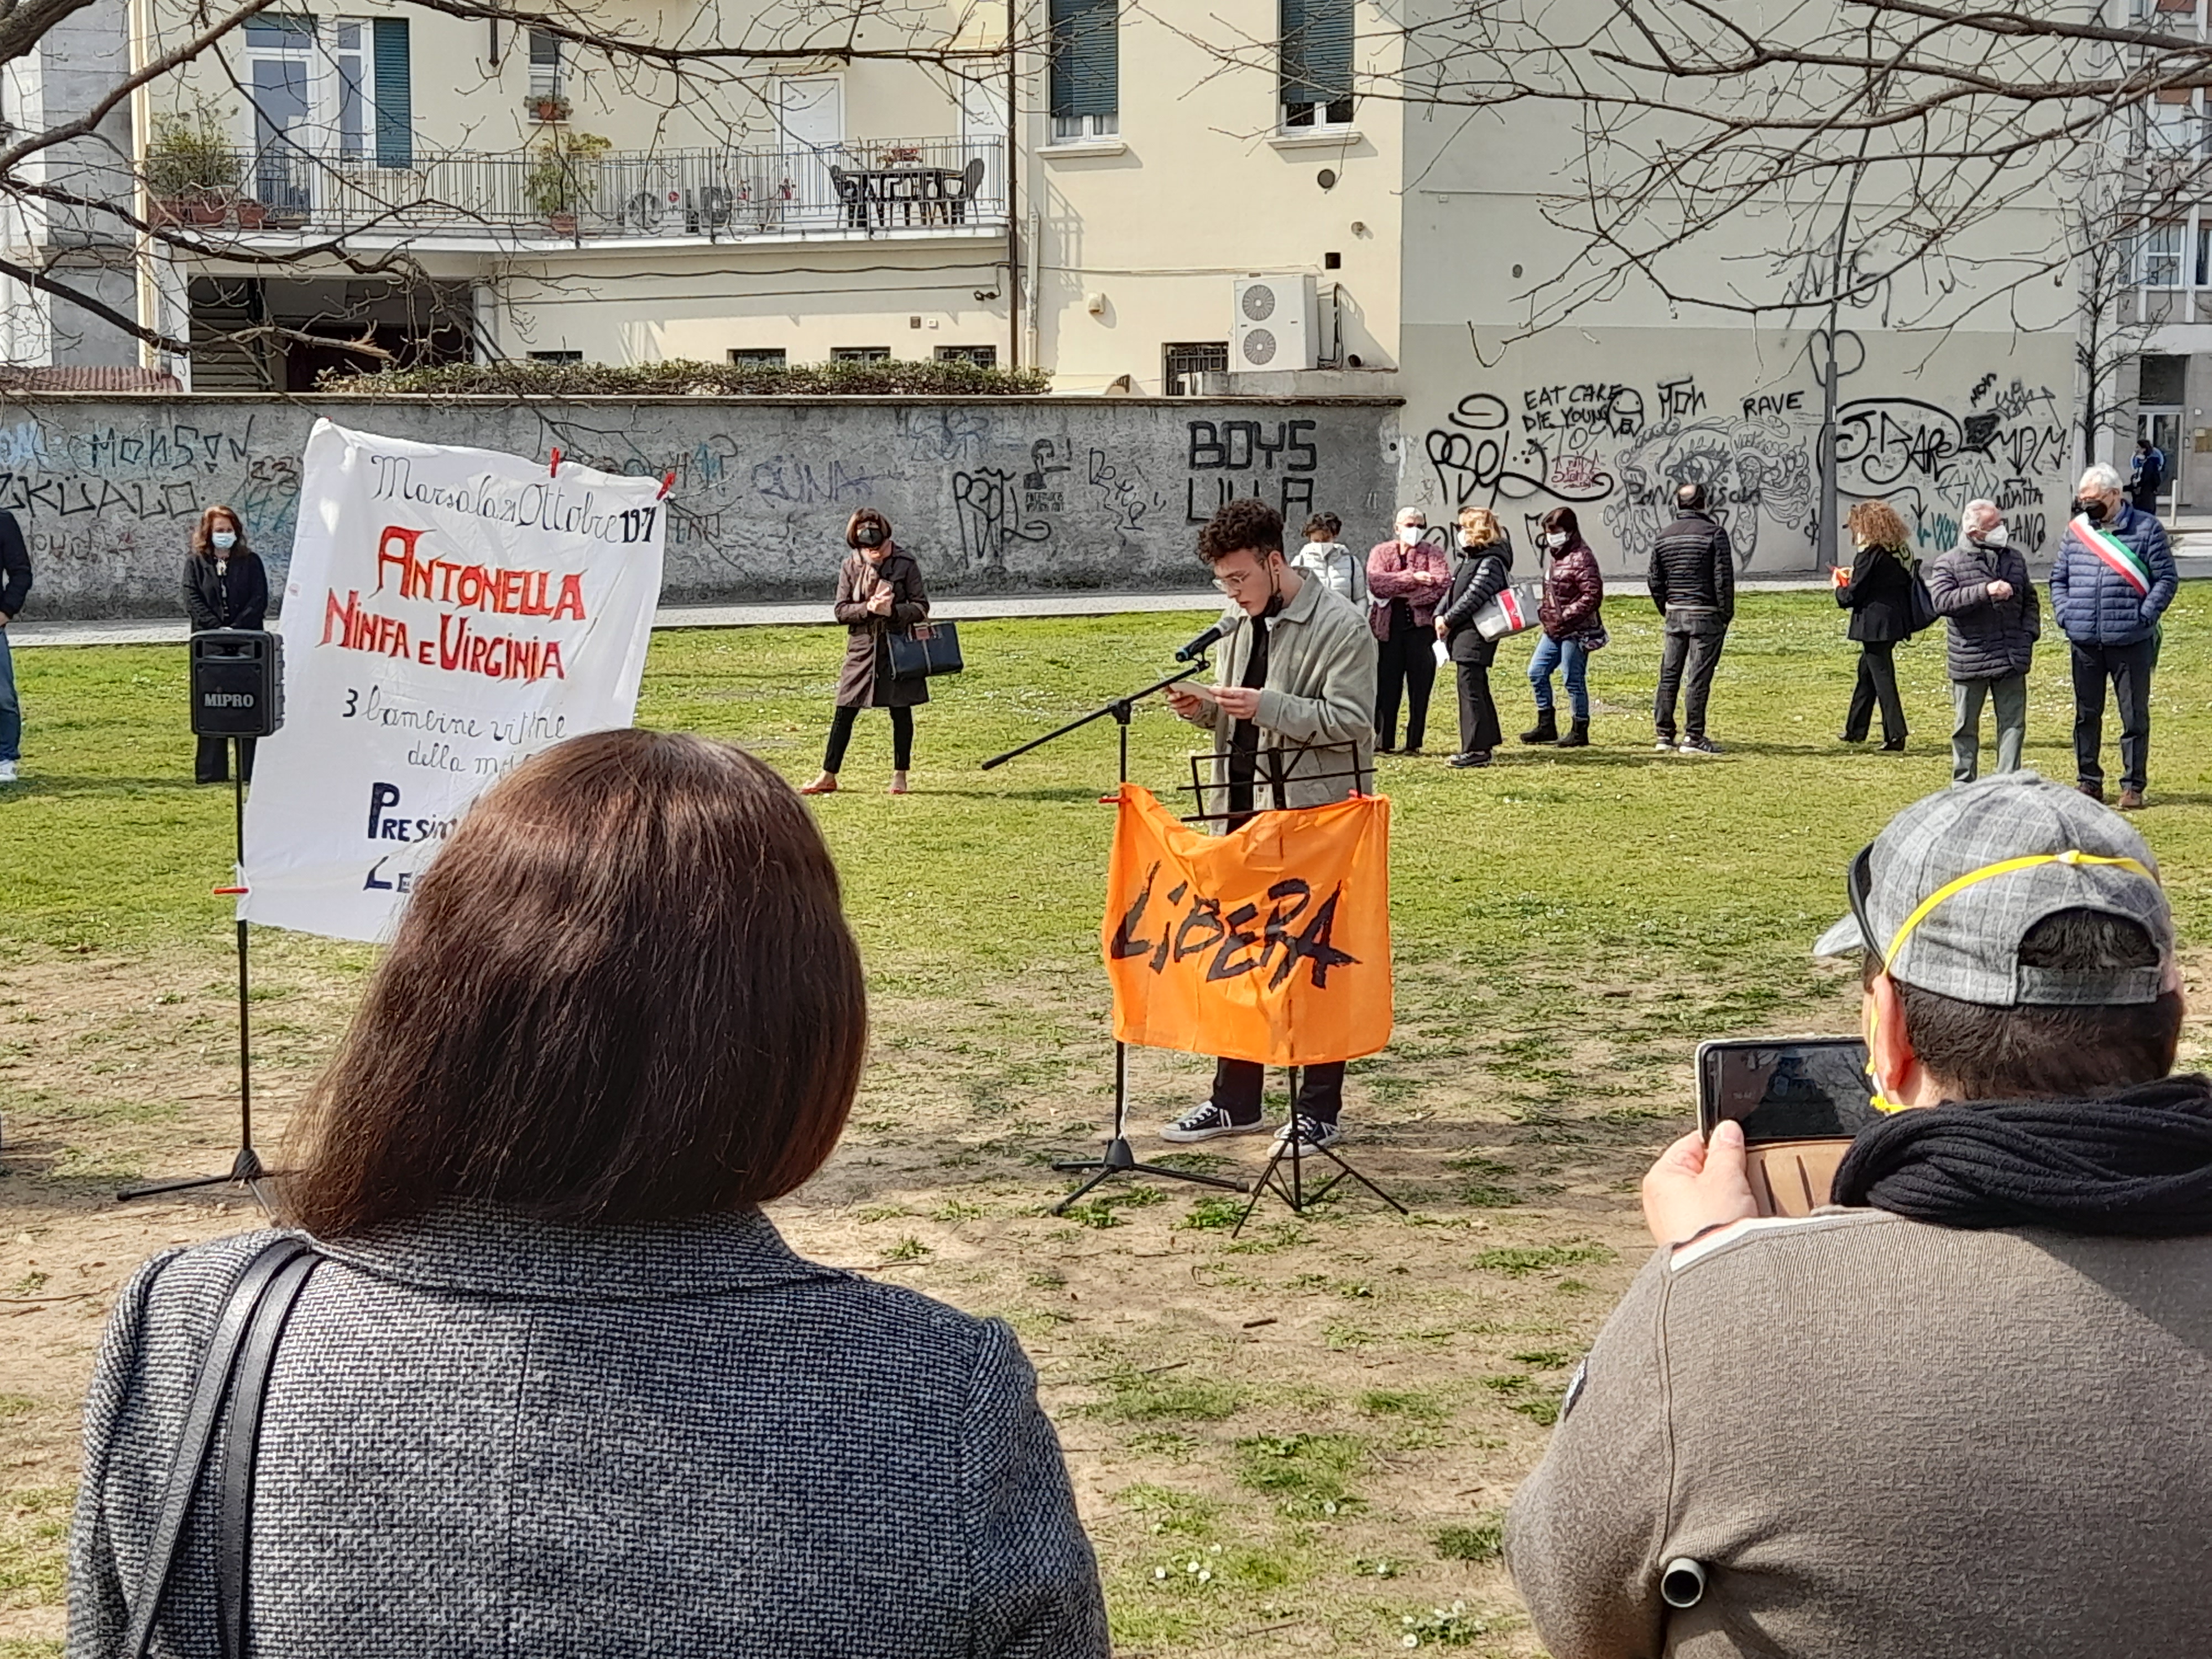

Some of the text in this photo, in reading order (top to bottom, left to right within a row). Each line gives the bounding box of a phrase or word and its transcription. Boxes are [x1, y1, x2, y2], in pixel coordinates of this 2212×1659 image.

[1521, 410, 1552, 433] DIE
[1524, 385, 1567, 410] EAT
[1743, 390, 1805, 422] RAVE
[1187, 419, 1317, 472] BOYS
[371, 455, 499, 519] Marsala
[515, 483, 619, 544] Ottobre
[368, 525, 589, 623] ANTONELLA
[315, 587, 410, 659] NINFA
[439, 612, 566, 689] VIRGINIA
[204, 693, 254, 708] MIPRO
[342, 687, 359, 718] 3
[362, 685, 486, 737] bambine
[408, 739, 466, 773] della
[1110, 860, 1363, 994] LIBERA
